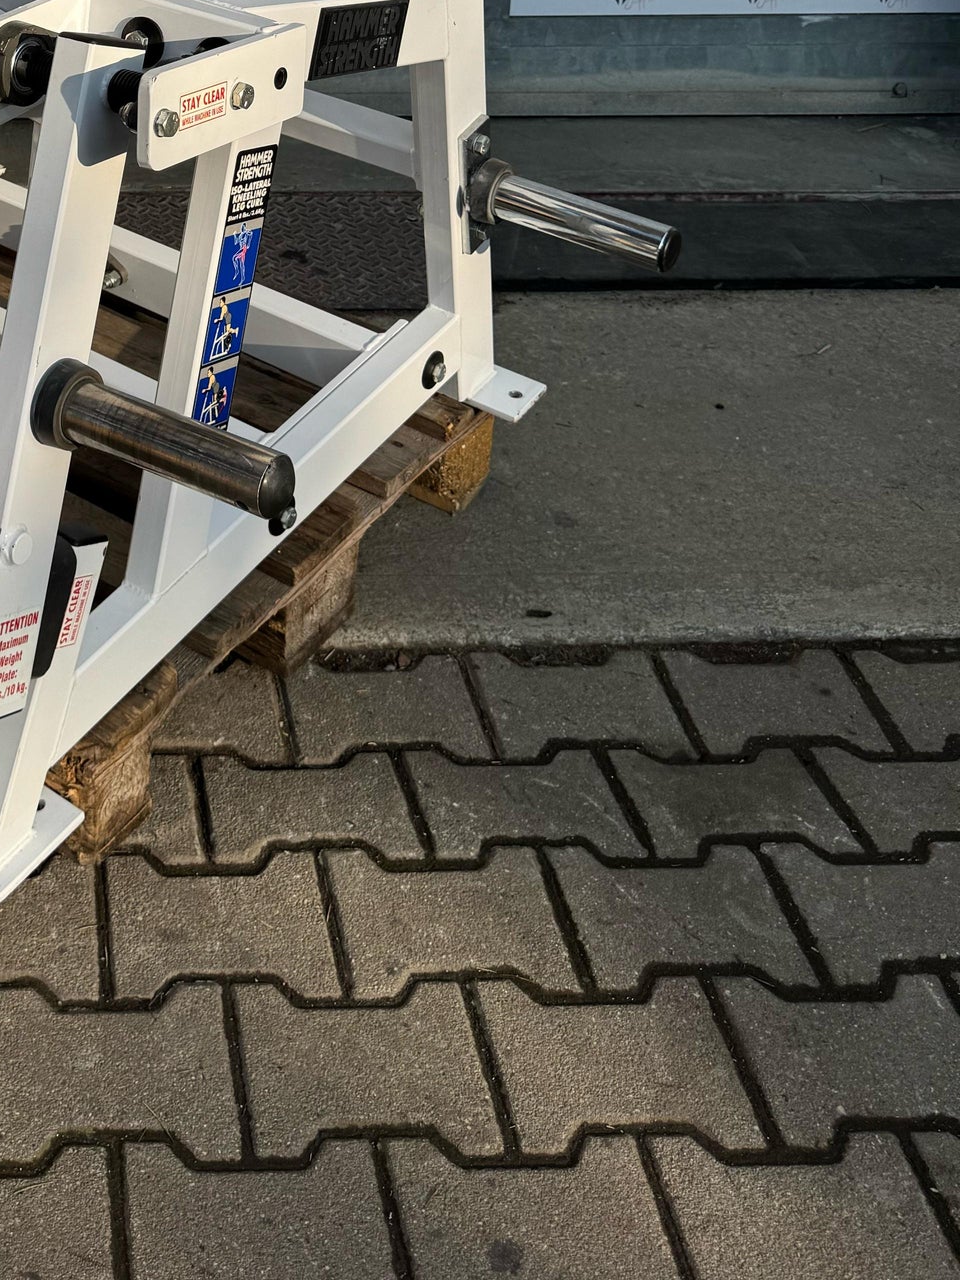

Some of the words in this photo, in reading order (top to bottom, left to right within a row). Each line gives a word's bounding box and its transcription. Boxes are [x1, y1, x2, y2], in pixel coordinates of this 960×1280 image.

[327, 6, 401, 42] HAMMER
[319, 35, 398, 75] STRENGTH
[182, 95, 201, 113] STAY
[203, 87, 225, 105] CLEAR
[240, 150, 273, 168] HAMMER
[235, 162, 272, 182] STRENGTH
[231, 178, 271, 195] ISO-LATERAL
[232, 188, 267, 204] KNEELING
[232, 202, 245, 212] LEG
[246, 198, 263, 209] CURL
[60, 617, 73, 644] STAY
[68, 579, 84, 613] CLEAR
[16, 682, 27, 694] kg.
